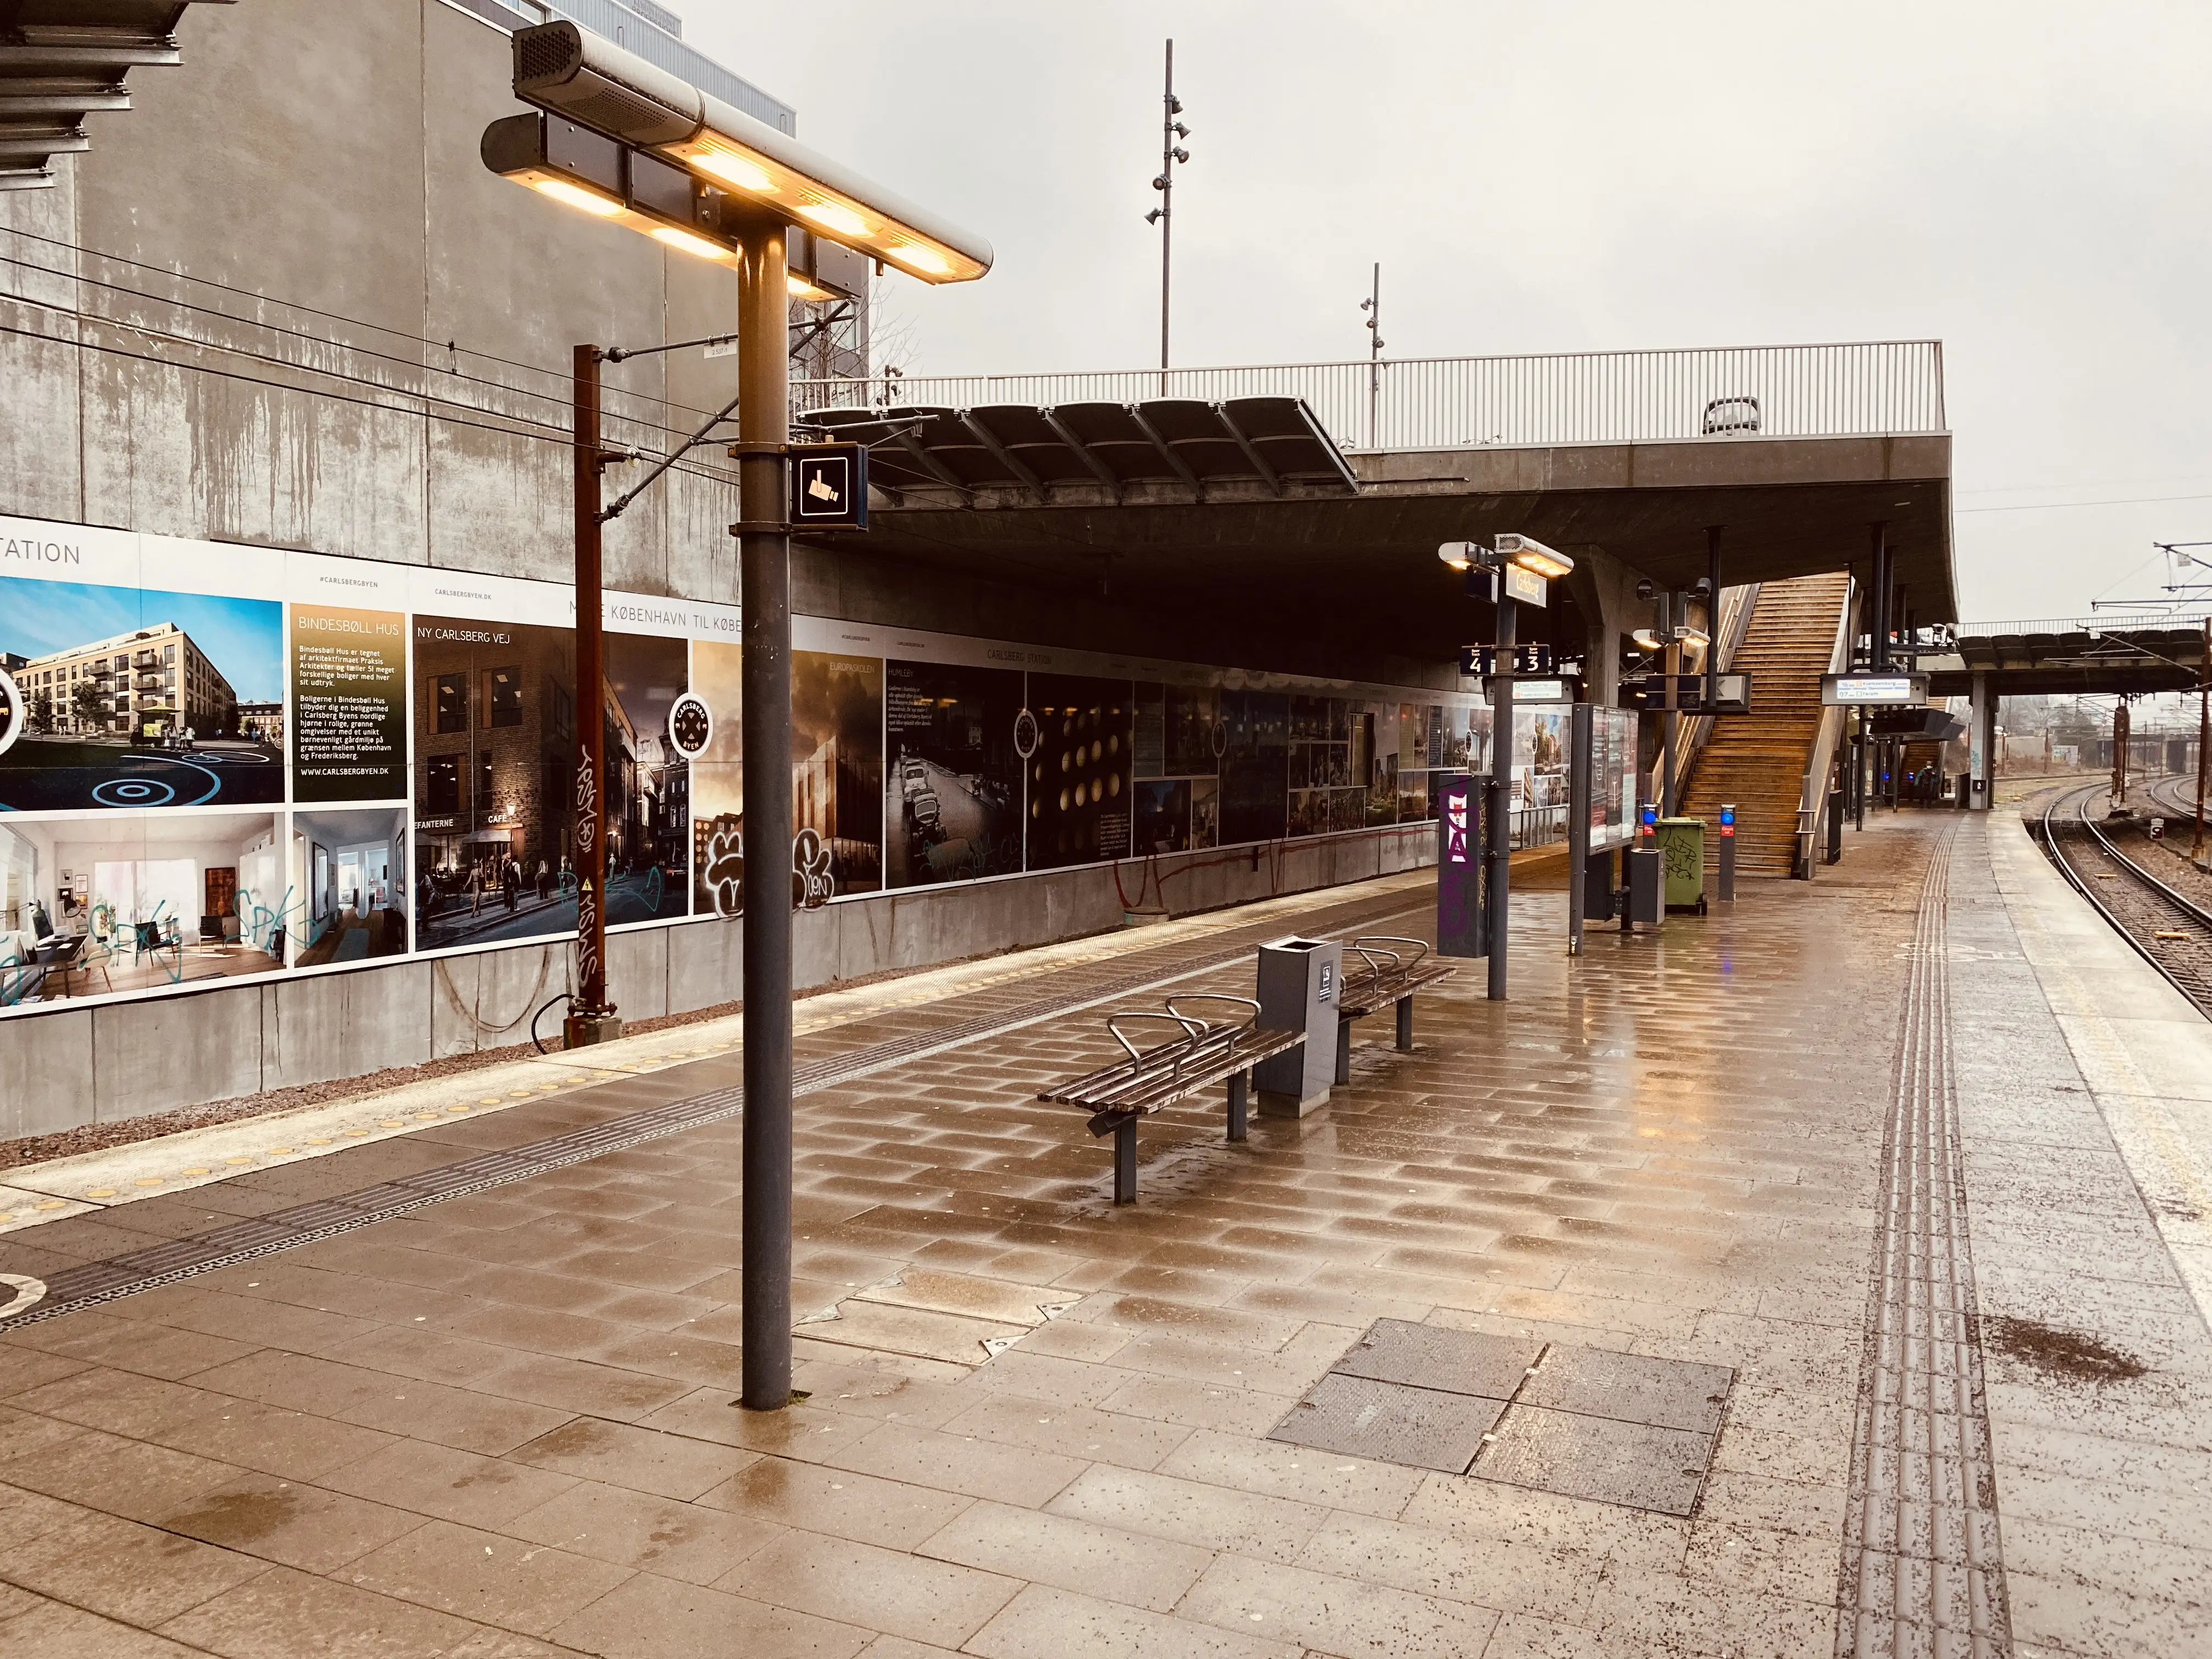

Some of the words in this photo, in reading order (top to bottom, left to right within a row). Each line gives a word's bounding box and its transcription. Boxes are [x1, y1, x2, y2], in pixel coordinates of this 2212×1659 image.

[0, 538, 79, 564] ATION
[320, 577, 378, 588] #CARLSBERGBYEN
[1516, 573, 1539, 600] Carlsberg
[435, 589, 492, 600] CARLSBERGBYEN.DK
[611, 605, 686, 626] KØBENHAVN
[693, 615, 709, 629] TIL
[714, 618, 741, 631] KØBE
[298, 616, 373, 634] BINDESBØLL
[376, 623, 399, 635] HUS
[417, 627, 432, 637] NY
[435, 628, 490, 642] CARLSBERG
[493, 633, 510, 644] VEJ
[299, 645, 334, 653] Bindesbøll
[308, 654, 358, 664] arkitektfirmaet
[988, 649, 1024, 662] CARLSBERG
[300, 662, 334, 670] Arkitekter
[1470, 658, 1481, 673] 4
[1527, 656, 1539, 671] 3
[300, 670, 335, 680] forskellige
[336, 672, 359, 681] boliger
[888, 668, 913, 678] HUMLEBY
[311, 680, 335, 688] udtryk.
[300, 695, 332, 703] Boligerne
[338, 696, 371, 704] Bindesbøll
[300, 703, 326, 712] tilbyder
[328, 704, 338, 712] dig
[351, 705, 388, 713] beliggenhed
[677, 702, 705, 719] CARLSBERG
[304, 712, 337, 720] Carlsberg
[338, 712, 358, 720] Byens
[360, 713, 386, 721] nordlige
[300, 719, 322, 728] hjørne
[329, 720, 349, 729] rolige,
[300, 736, 342, 744] børnevenligt
[344, 736, 374, 744] gårdmiljø
[375, 736, 383, 744] på
[683, 741, 699, 749] BYEN
[311, 752, 359, 760] Frederiksberg.
